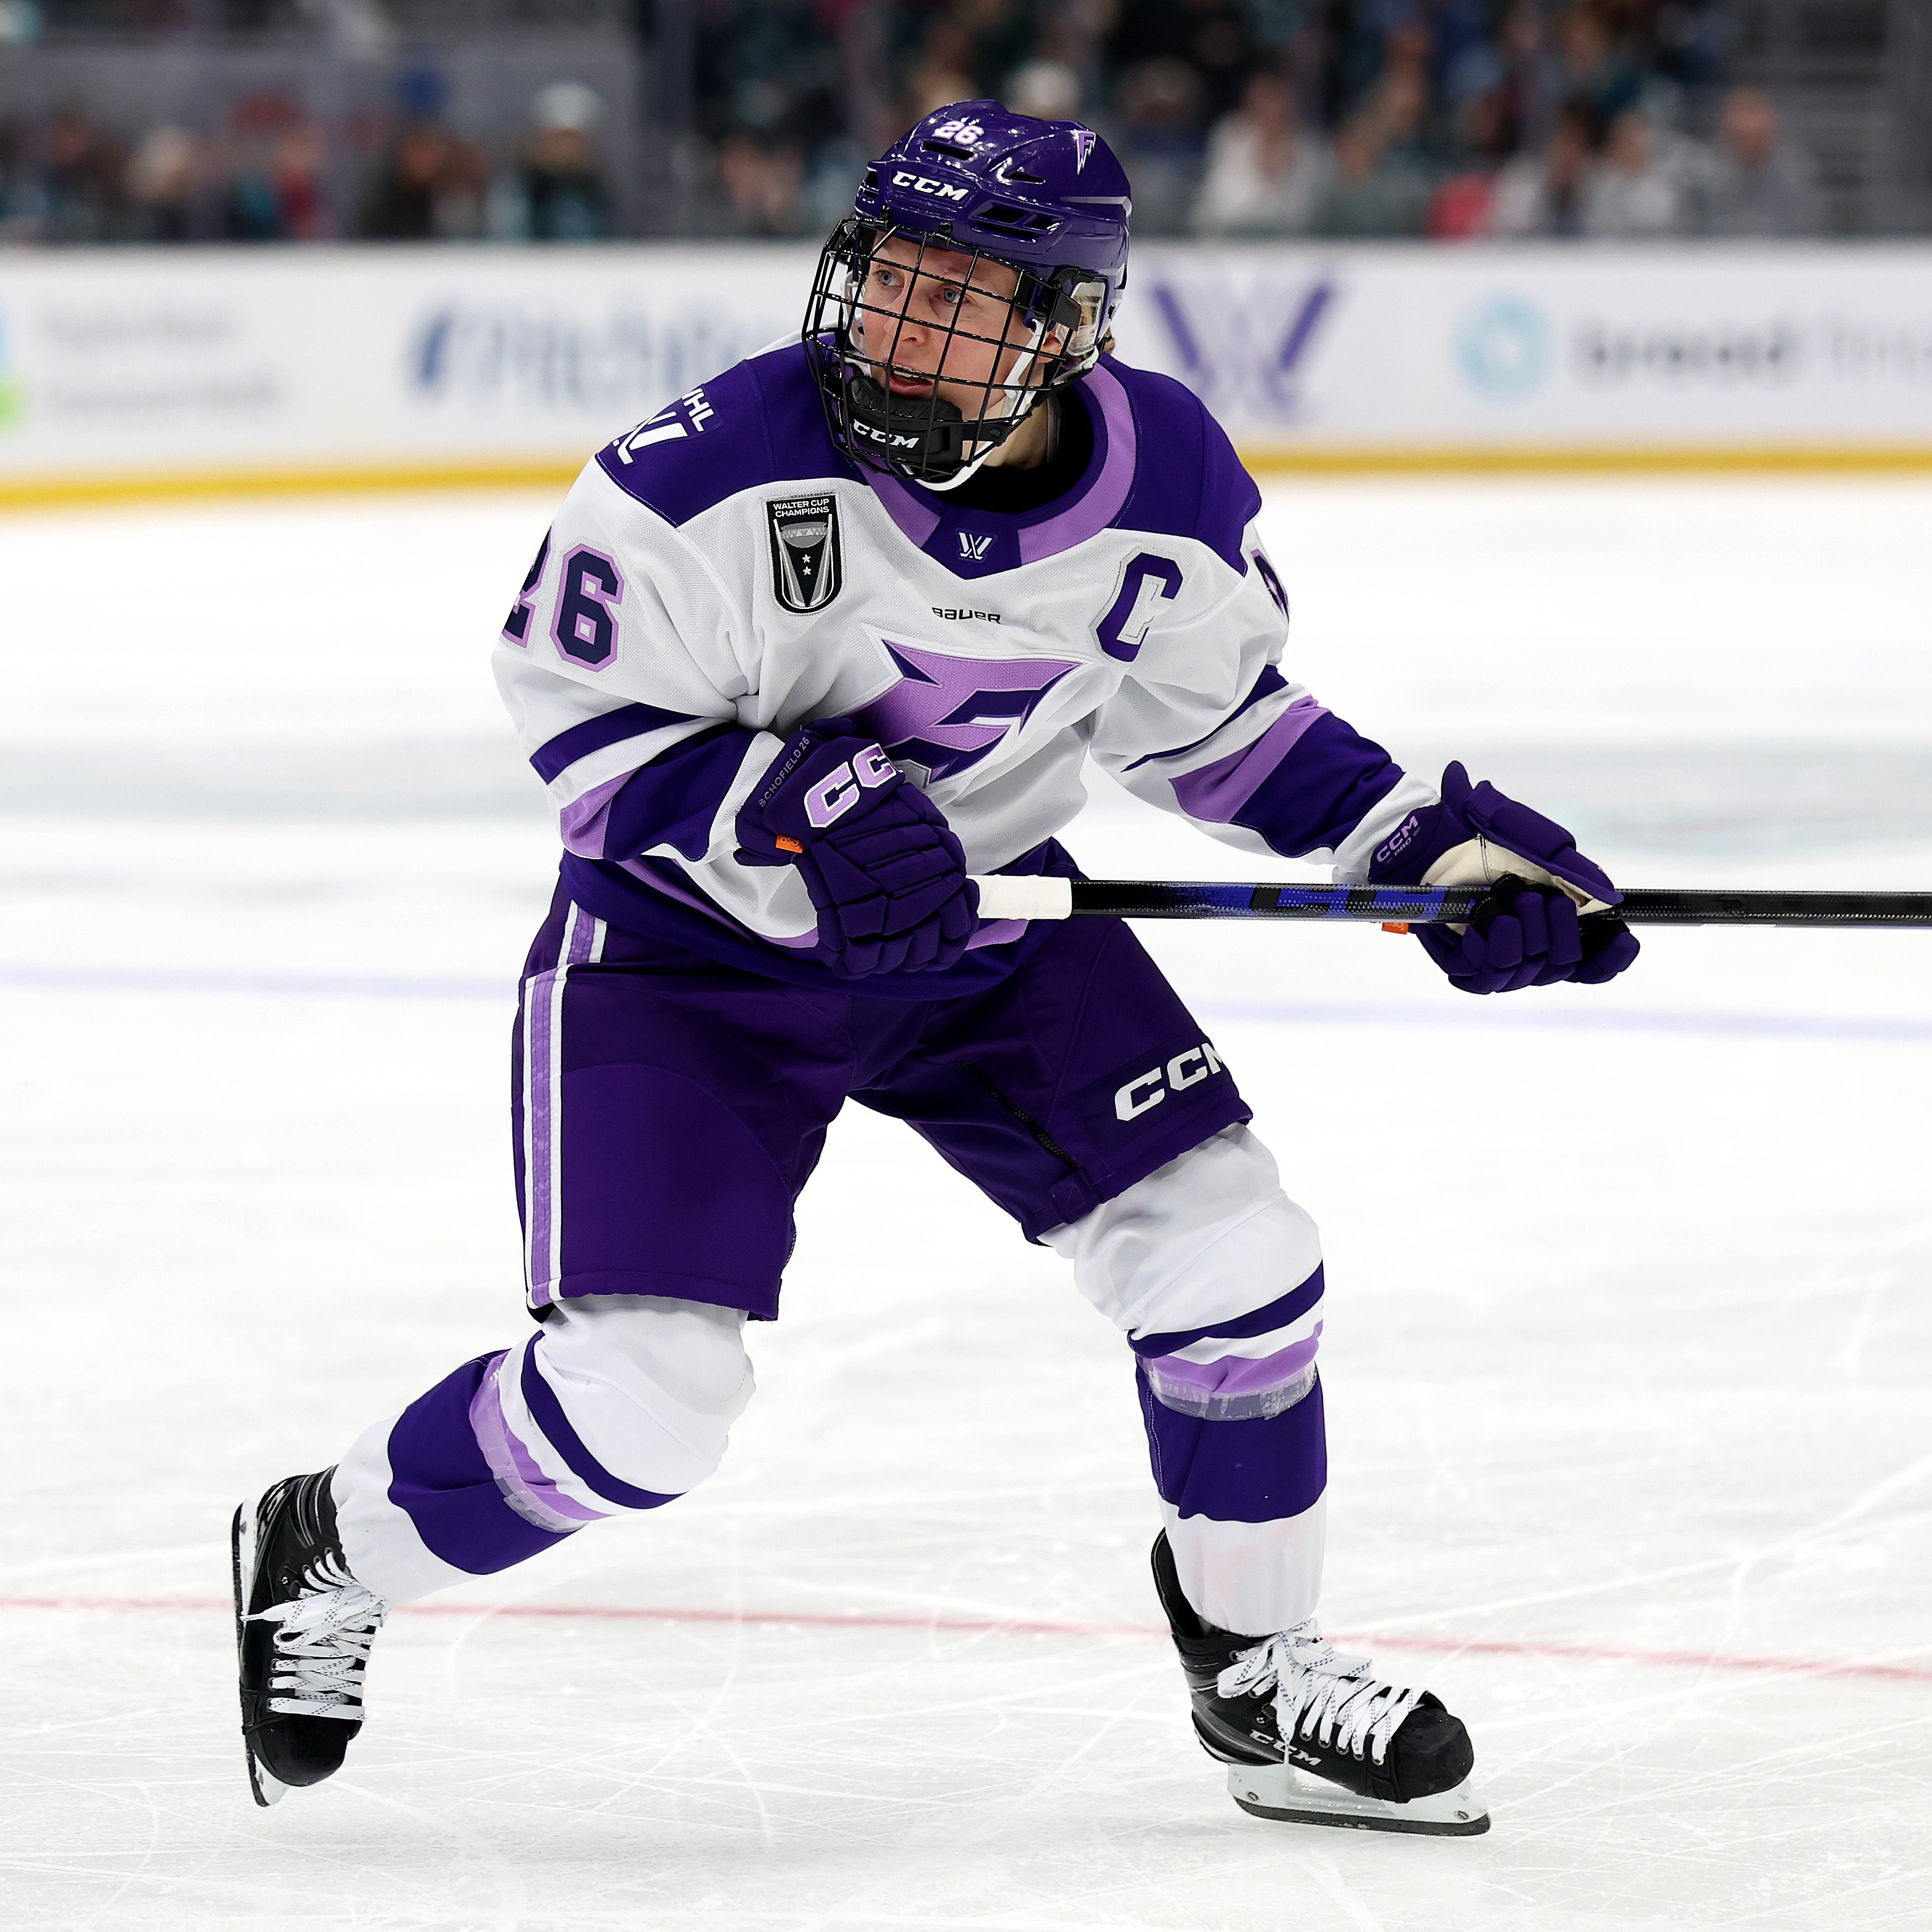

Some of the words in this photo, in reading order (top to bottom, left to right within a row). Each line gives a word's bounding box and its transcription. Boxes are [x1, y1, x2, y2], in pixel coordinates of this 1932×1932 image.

[931, 120, 985, 145] 26
[892, 171, 969, 201] CCM
[854, 418, 919, 448] CCM
[773, 500, 809, 510] WALTER
[810, 498, 829, 507] CUP
[775, 506, 829, 517] CHAMPIONS
[932, 607, 1001, 624] BAUER
[1096, 552, 1183, 656] C
[758, 749, 801, 807] SCHOFIELD
[799, 736, 810, 751] 26
[804, 743, 903, 828] CC
[1376, 815, 1418, 862] CCM
[1394, 837, 1412, 856] PRO
[1250, 1729, 1323, 1766] CCM
